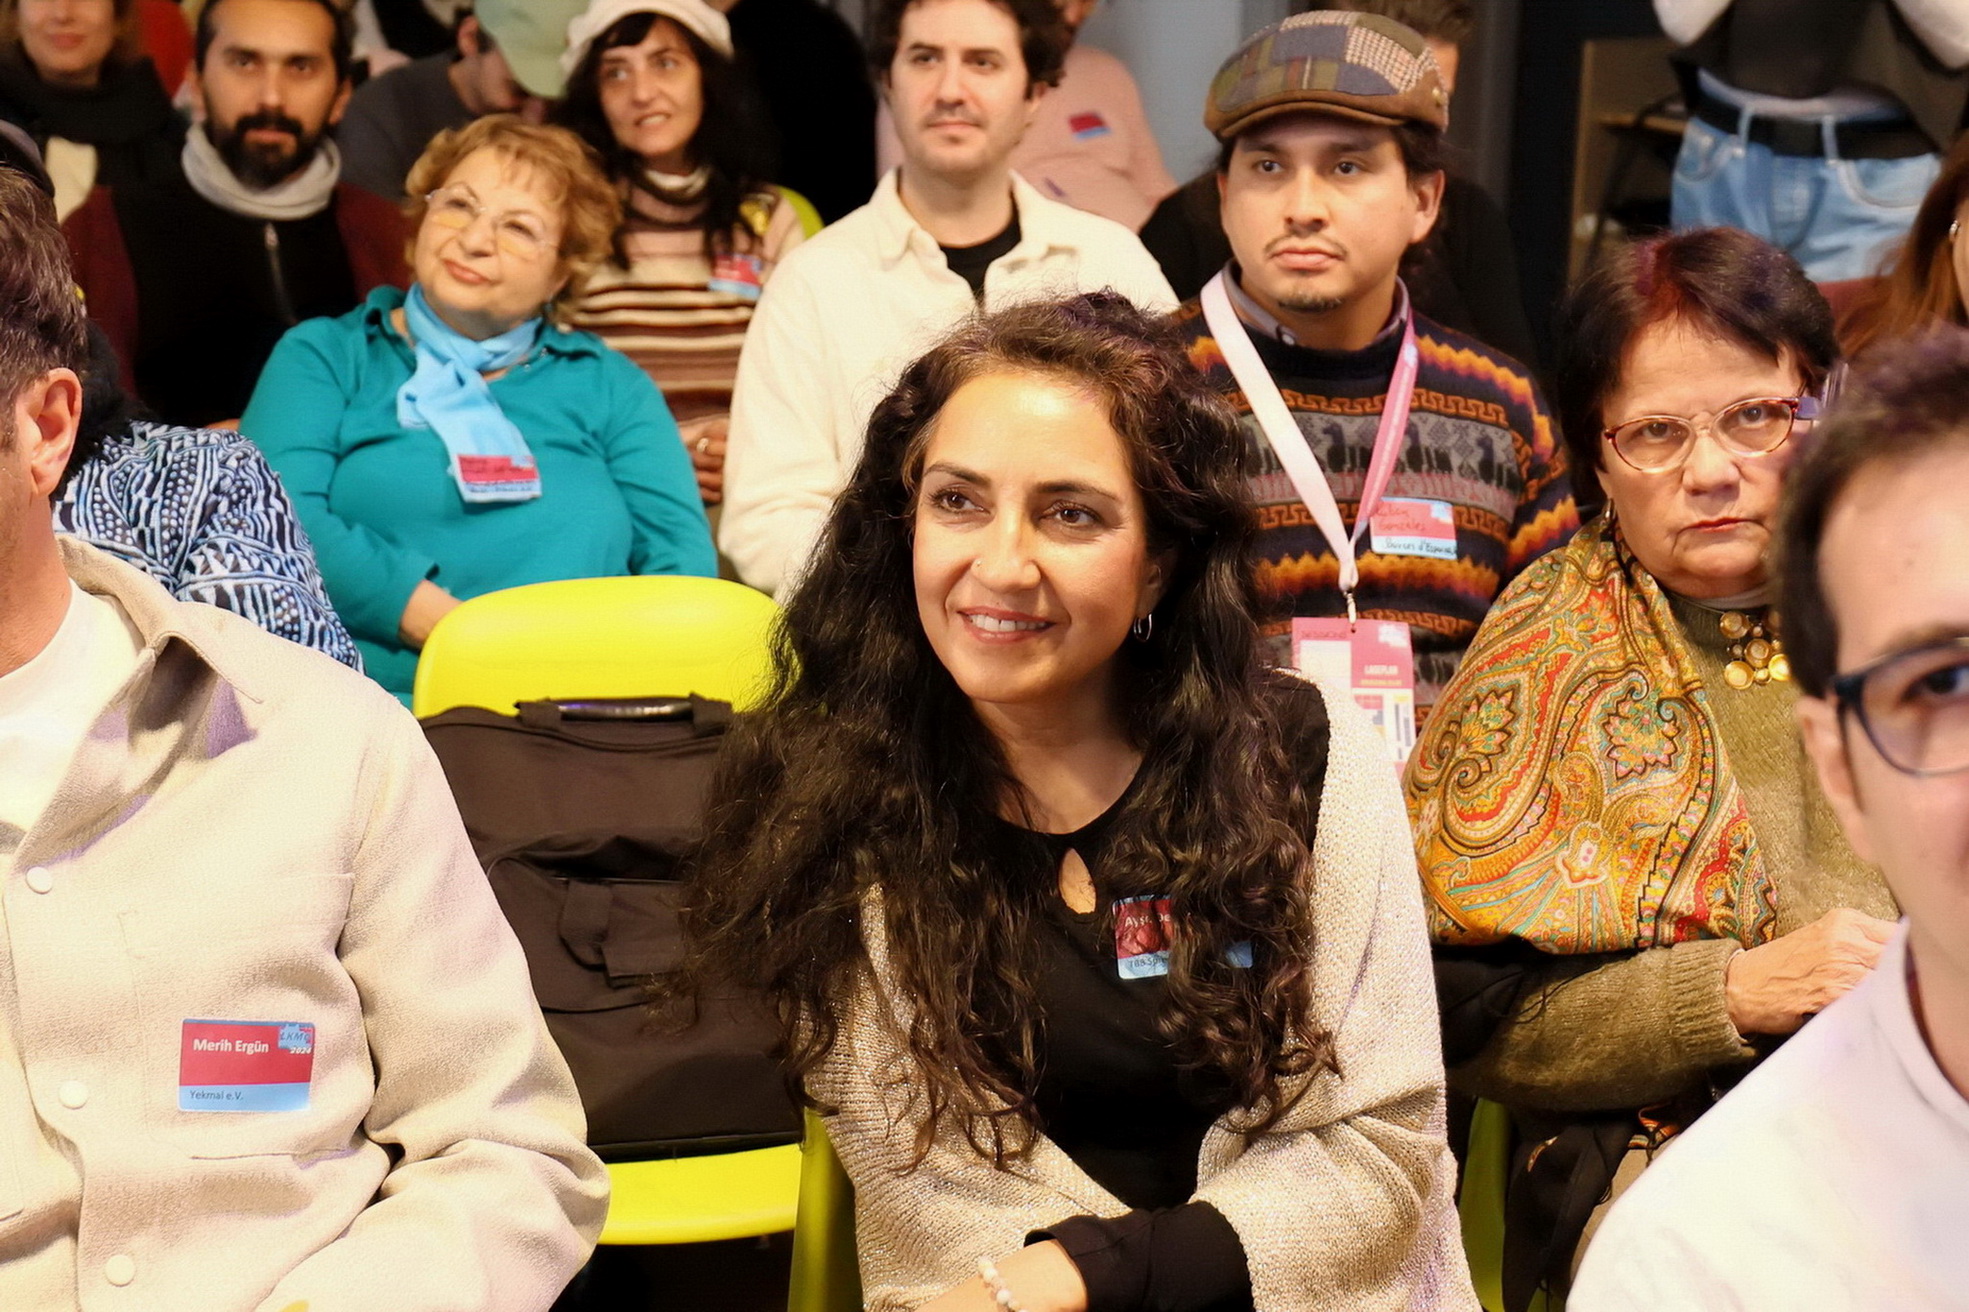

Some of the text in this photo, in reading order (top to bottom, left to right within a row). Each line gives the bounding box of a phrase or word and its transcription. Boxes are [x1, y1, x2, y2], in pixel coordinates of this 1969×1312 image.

[193, 1039, 270, 1055] Merih Ergün
[189, 1090, 225, 1101] Yekmal
